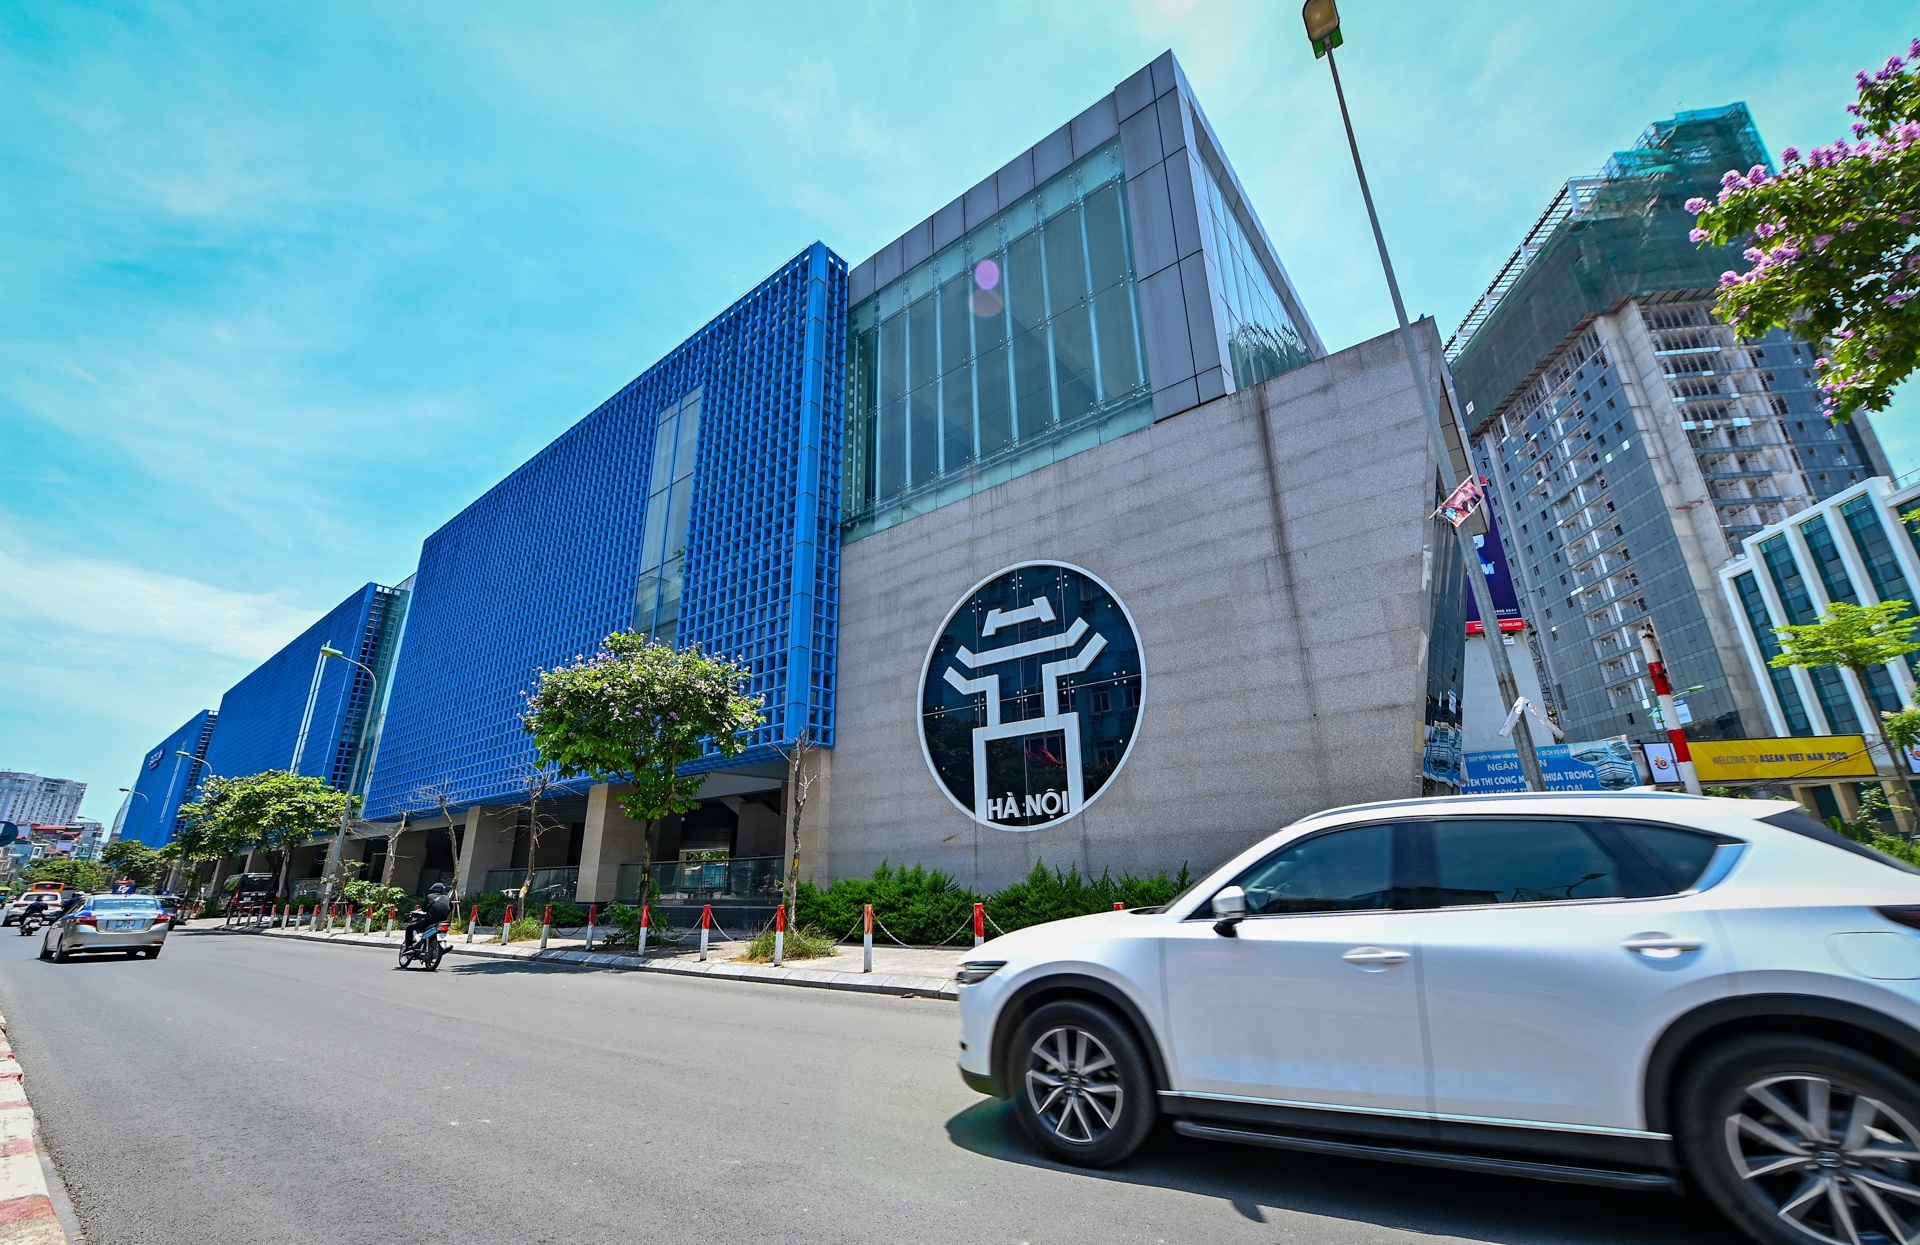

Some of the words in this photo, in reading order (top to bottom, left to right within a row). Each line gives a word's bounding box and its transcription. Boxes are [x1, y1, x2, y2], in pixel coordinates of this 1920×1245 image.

[1486, 760, 1518, 771] NGÂN
[1711, 755, 1748, 765] WELCOME
[1747, 754, 1759, 764] TO
[1759, 753, 1786, 763] ASEAN
[1786, 753, 1805, 762] VIET
[1805, 752, 1826, 761] NAM
[1480, 776, 1494, 786] THI
[1563, 770, 1595, 780] TRONG
[987, 791, 1021, 820] HÀ
[1025, 788, 1069, 819] NỘI
